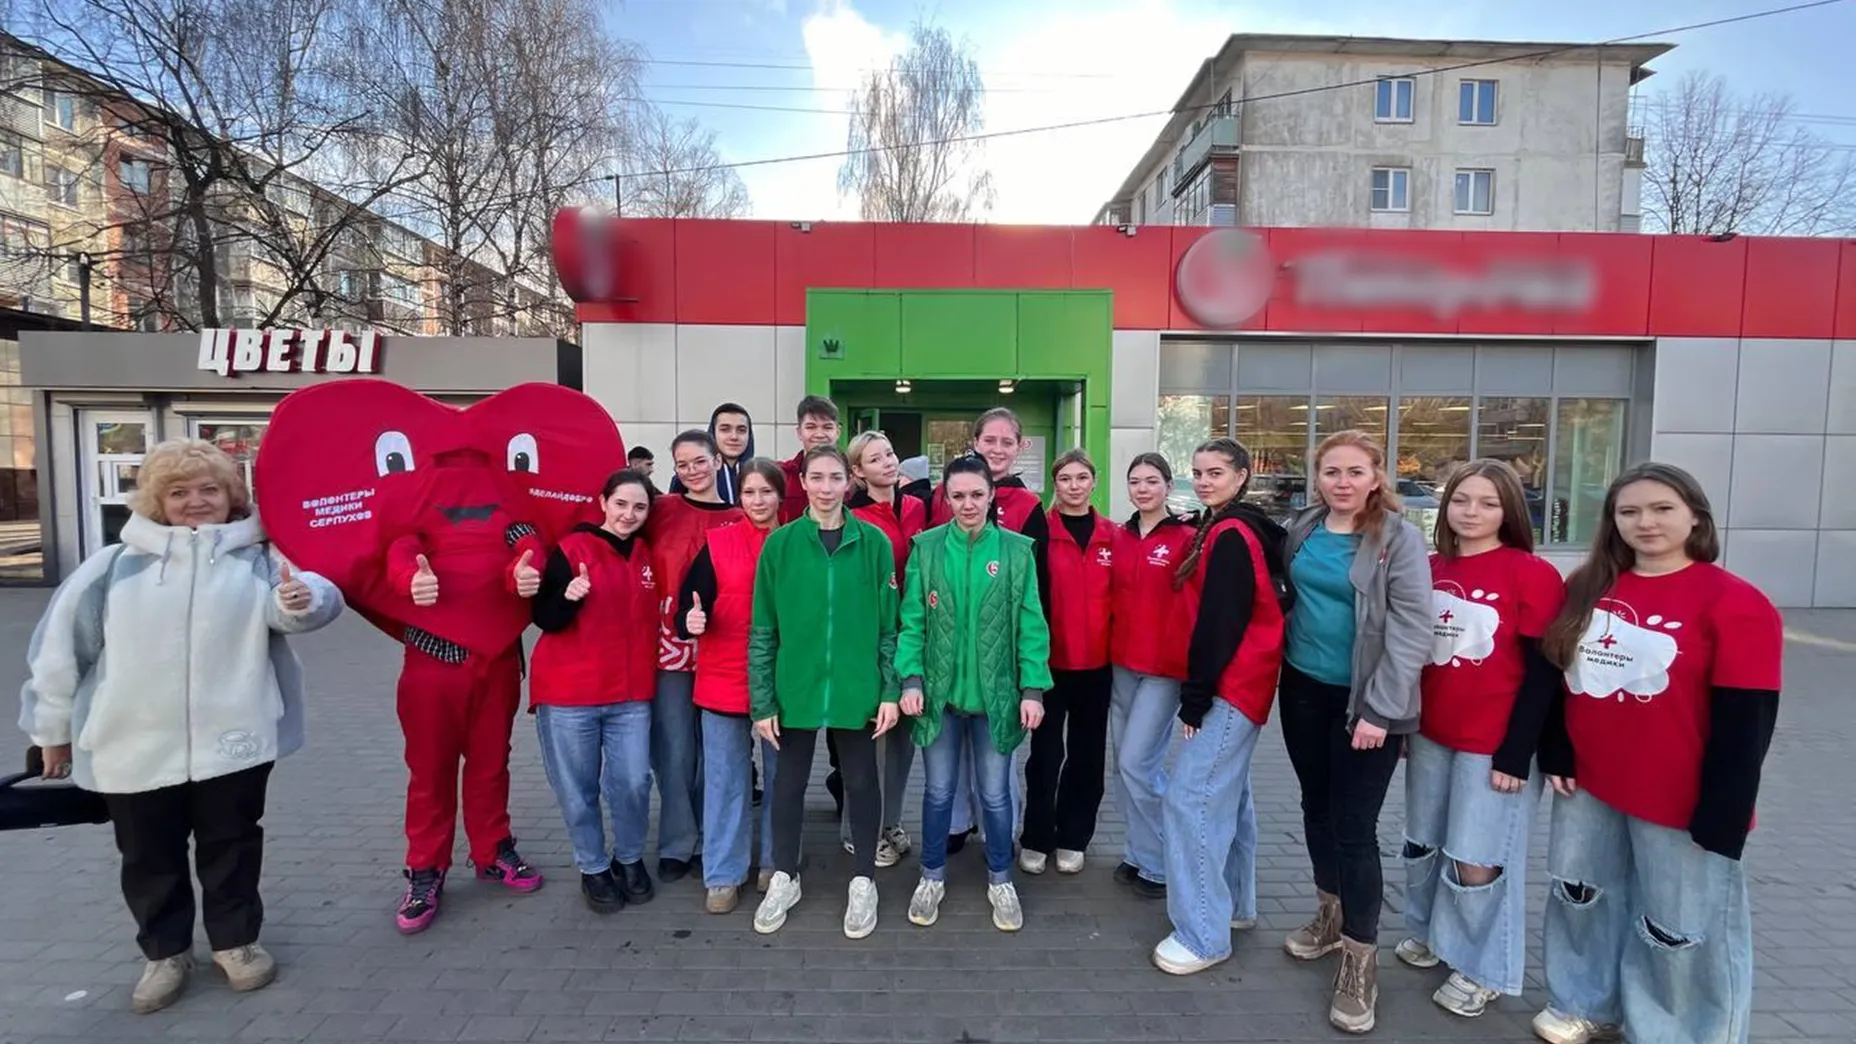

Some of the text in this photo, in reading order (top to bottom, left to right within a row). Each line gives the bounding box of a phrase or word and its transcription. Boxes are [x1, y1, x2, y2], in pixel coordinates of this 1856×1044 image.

[197, 328, 377, 376] ЦВЕТЫ
[302, 488, 375, 509] ВОЛОНТЕРЫ
[315, 502, 362, 516] МЕДИКИ
[309, 510, 372, 528] СЕРПУХОВ
[1578, 645, 1634, 662] Волонтеры
[1586, 656, 1625, 668] медики
